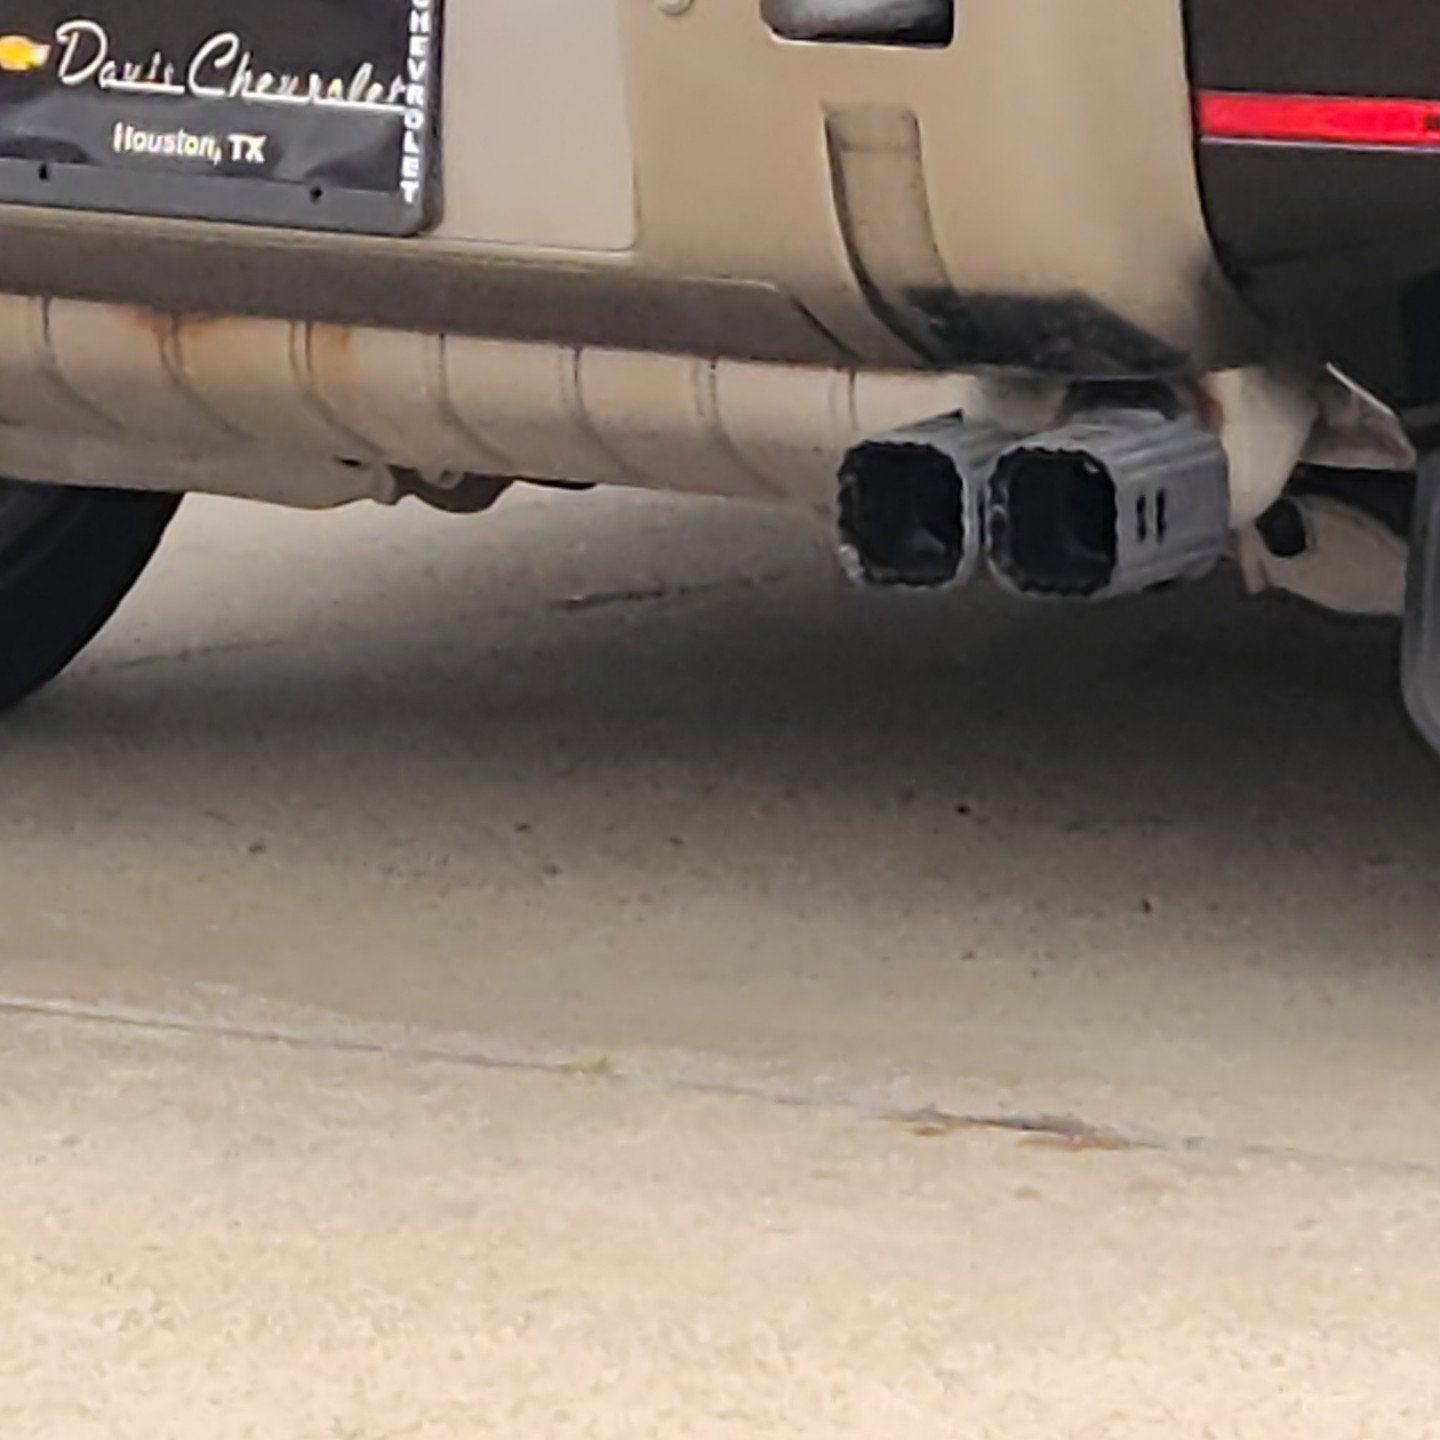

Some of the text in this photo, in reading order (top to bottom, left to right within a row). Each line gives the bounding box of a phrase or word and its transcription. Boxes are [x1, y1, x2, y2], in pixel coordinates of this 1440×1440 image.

[55, 19, 408, 112] Davis Chevrolet
[113, 121, 267, 166] Houston, TX
